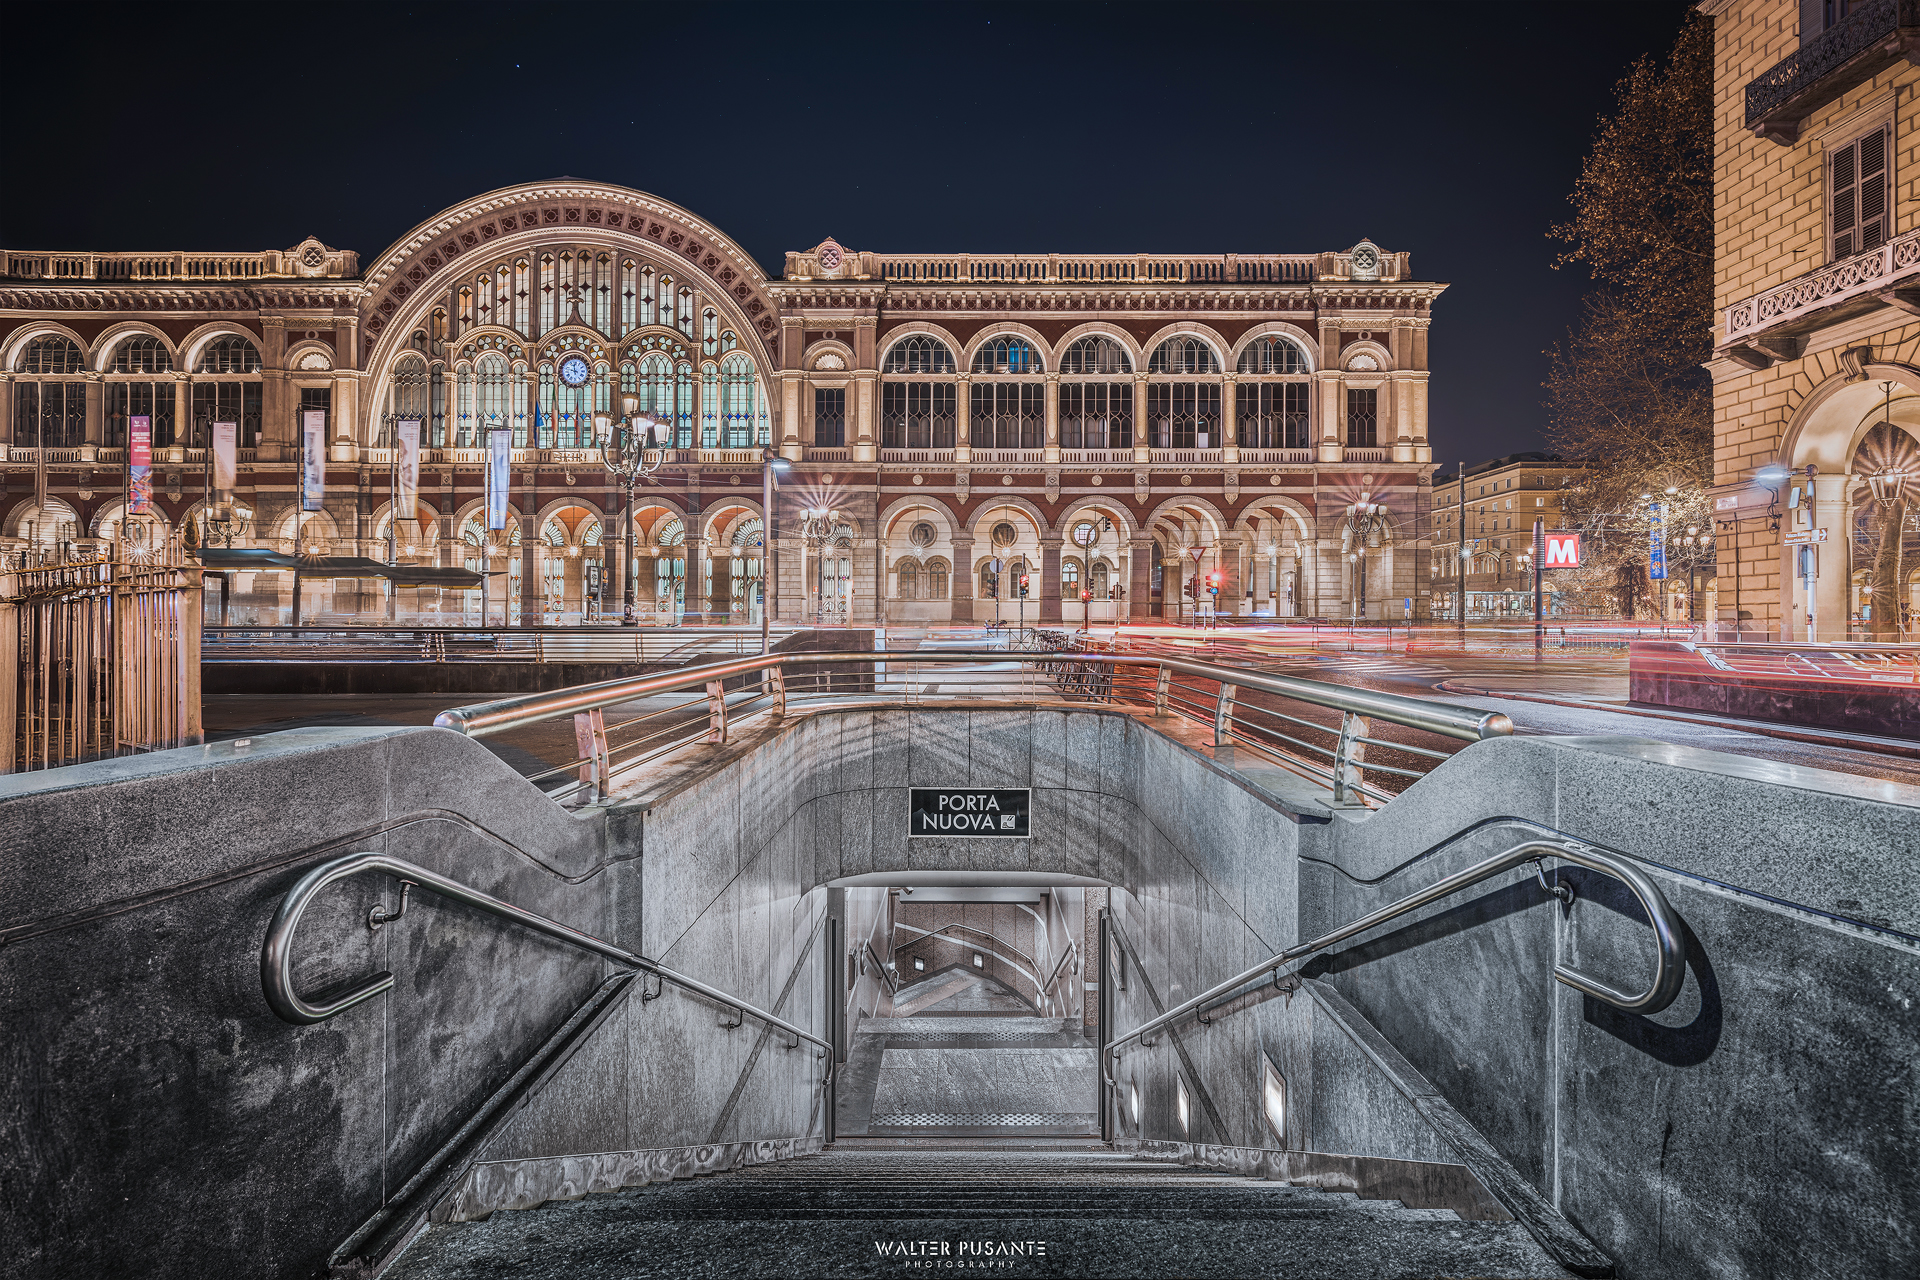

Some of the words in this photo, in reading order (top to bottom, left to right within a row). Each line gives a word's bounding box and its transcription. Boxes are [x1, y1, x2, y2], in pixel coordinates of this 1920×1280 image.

[1547, 539, 1577, 564] M
[939, 795, 1000, 811] PORTA
[923, 813, 996, 830] NUOVA
